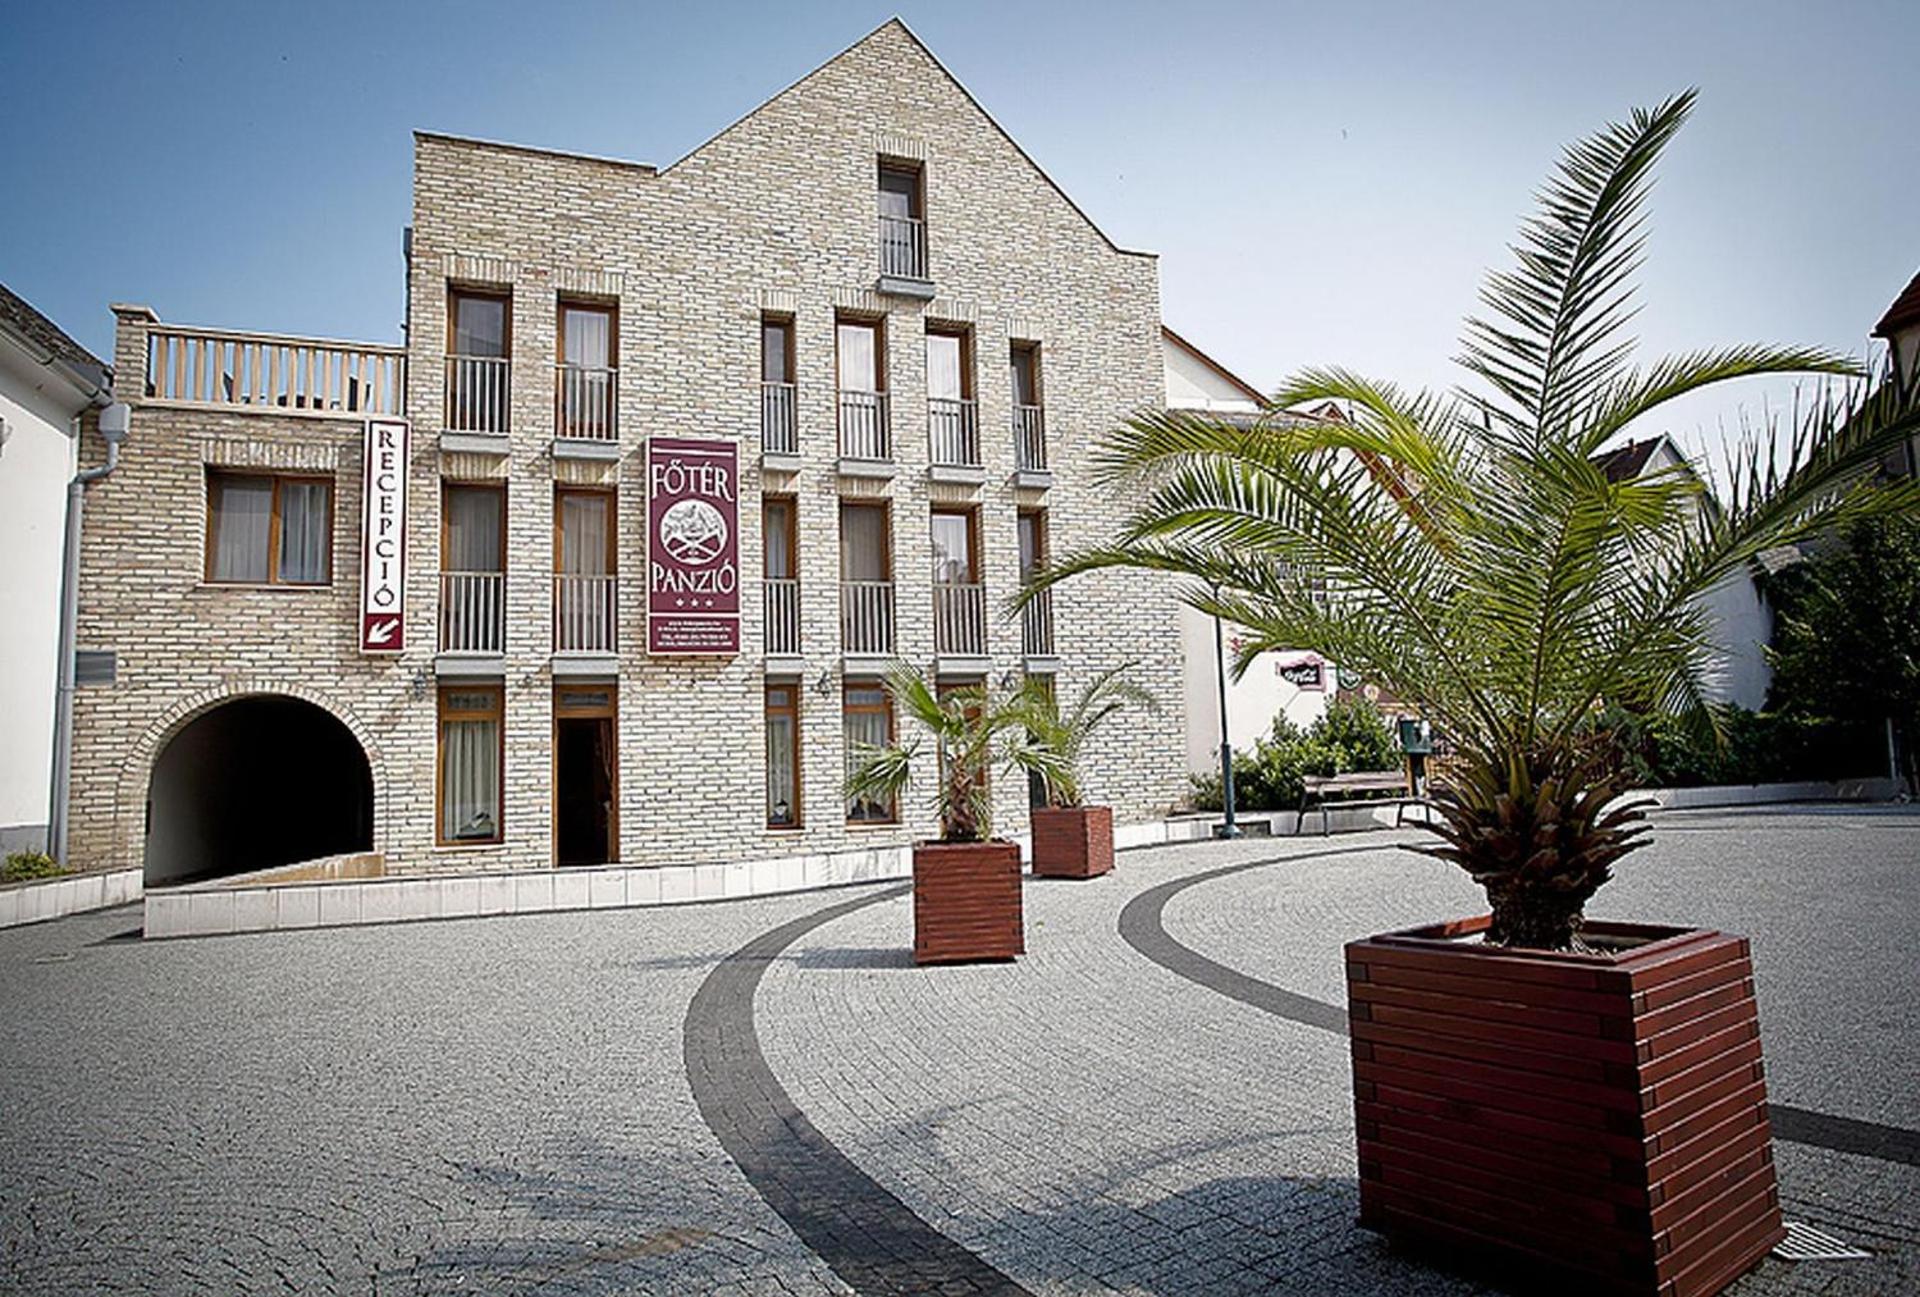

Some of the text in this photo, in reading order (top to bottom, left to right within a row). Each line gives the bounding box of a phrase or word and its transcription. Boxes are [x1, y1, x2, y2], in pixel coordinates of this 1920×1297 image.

[652, 459, 735, 502] FŐTÉR
[374, 430, 396, 607] RECEPCIÓ
[652, 558, 736, 594] PANZIÓ
